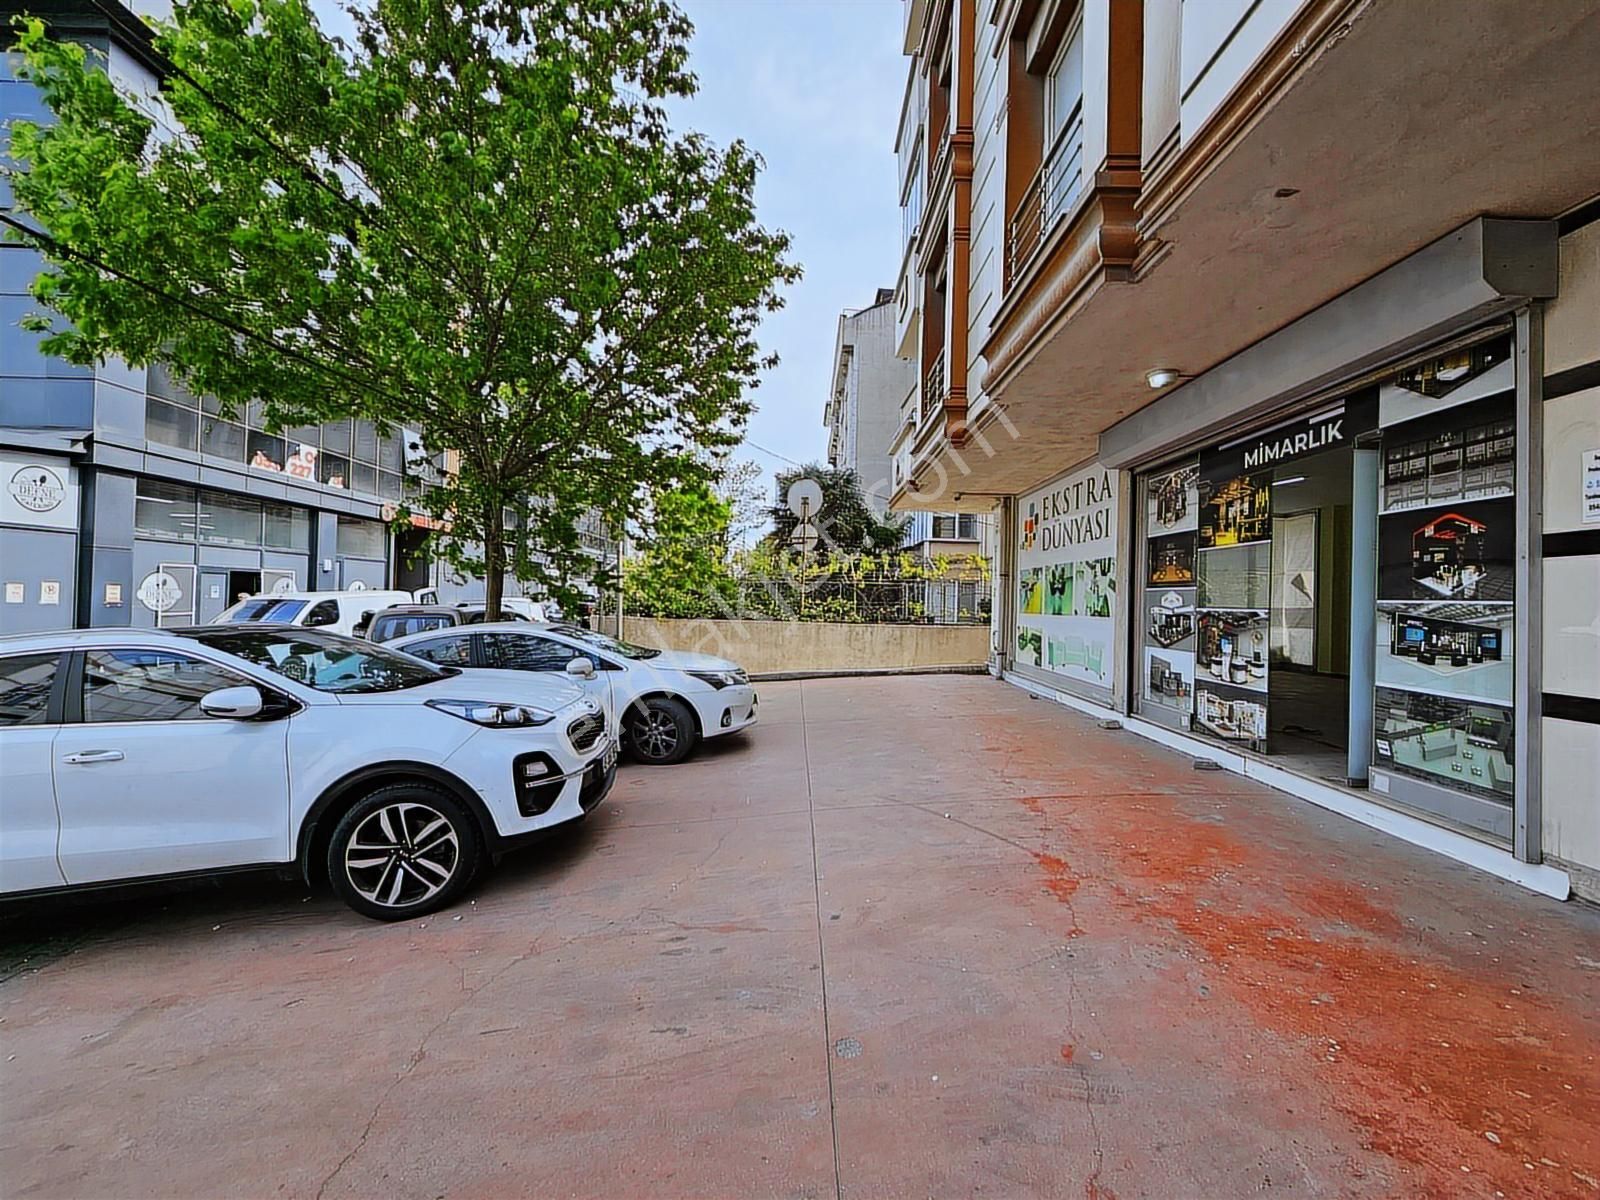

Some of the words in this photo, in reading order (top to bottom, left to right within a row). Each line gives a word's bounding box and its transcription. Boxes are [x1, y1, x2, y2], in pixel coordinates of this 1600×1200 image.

[1244, 419, 1344, 469] MİMARLIK
[1042, 470, 1113, 521] EKSTRA
[1042, 508, 1110, 551] DÜNYASI
